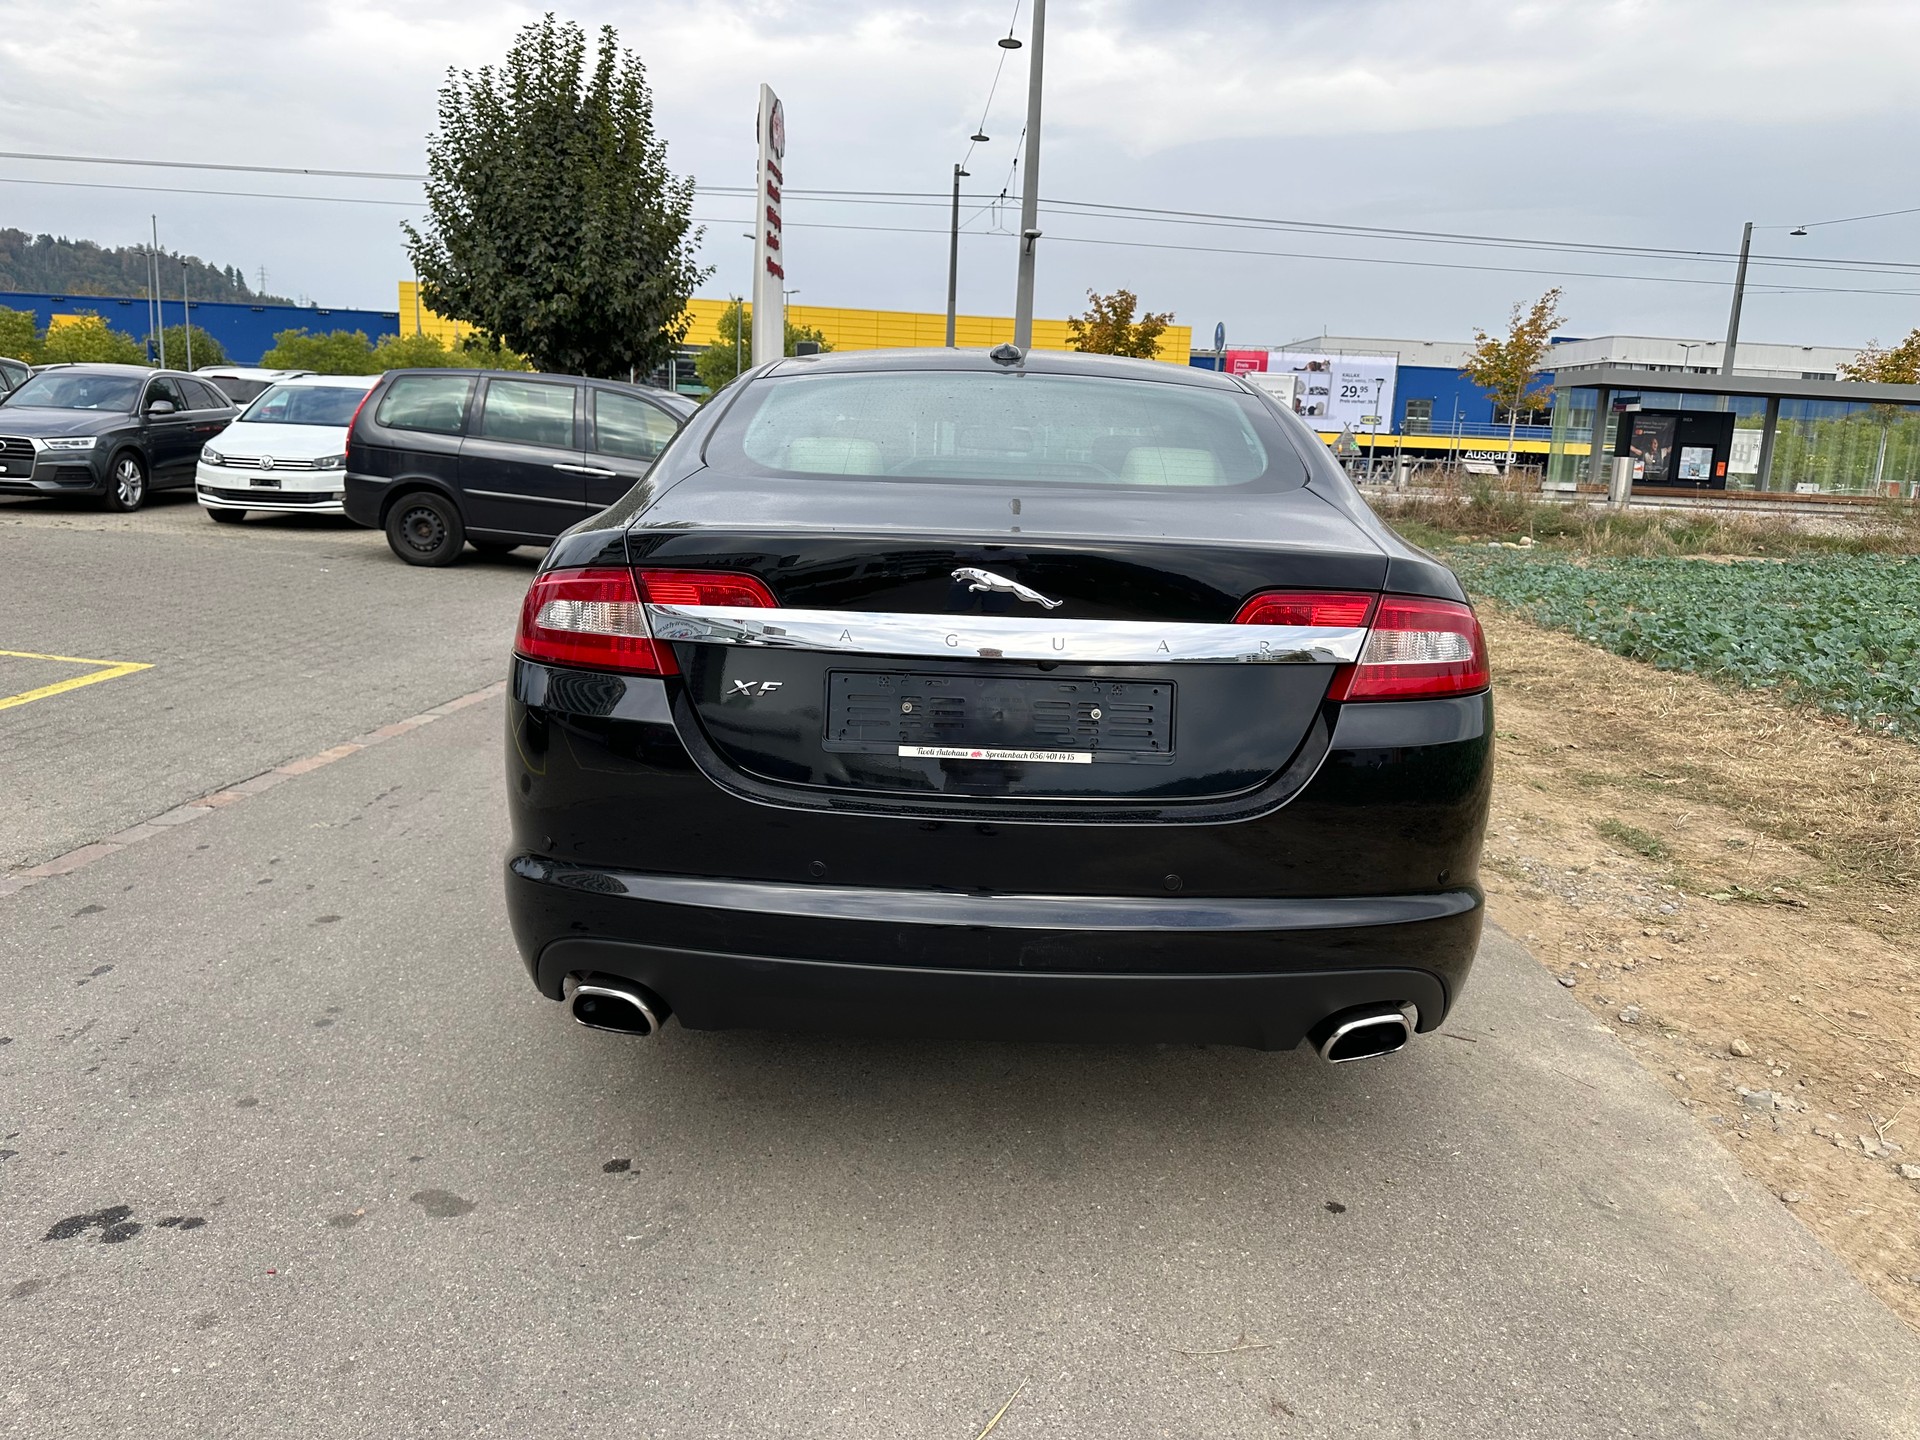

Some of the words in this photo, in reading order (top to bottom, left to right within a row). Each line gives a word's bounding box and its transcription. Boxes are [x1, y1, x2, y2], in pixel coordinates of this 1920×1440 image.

[726, 679, 784, 697] XF
[936, 748, 969, 757] Autohaus
[985, 750, 1028, 760] Spreitenbach
[1067, 753, 1075, 761] 15
